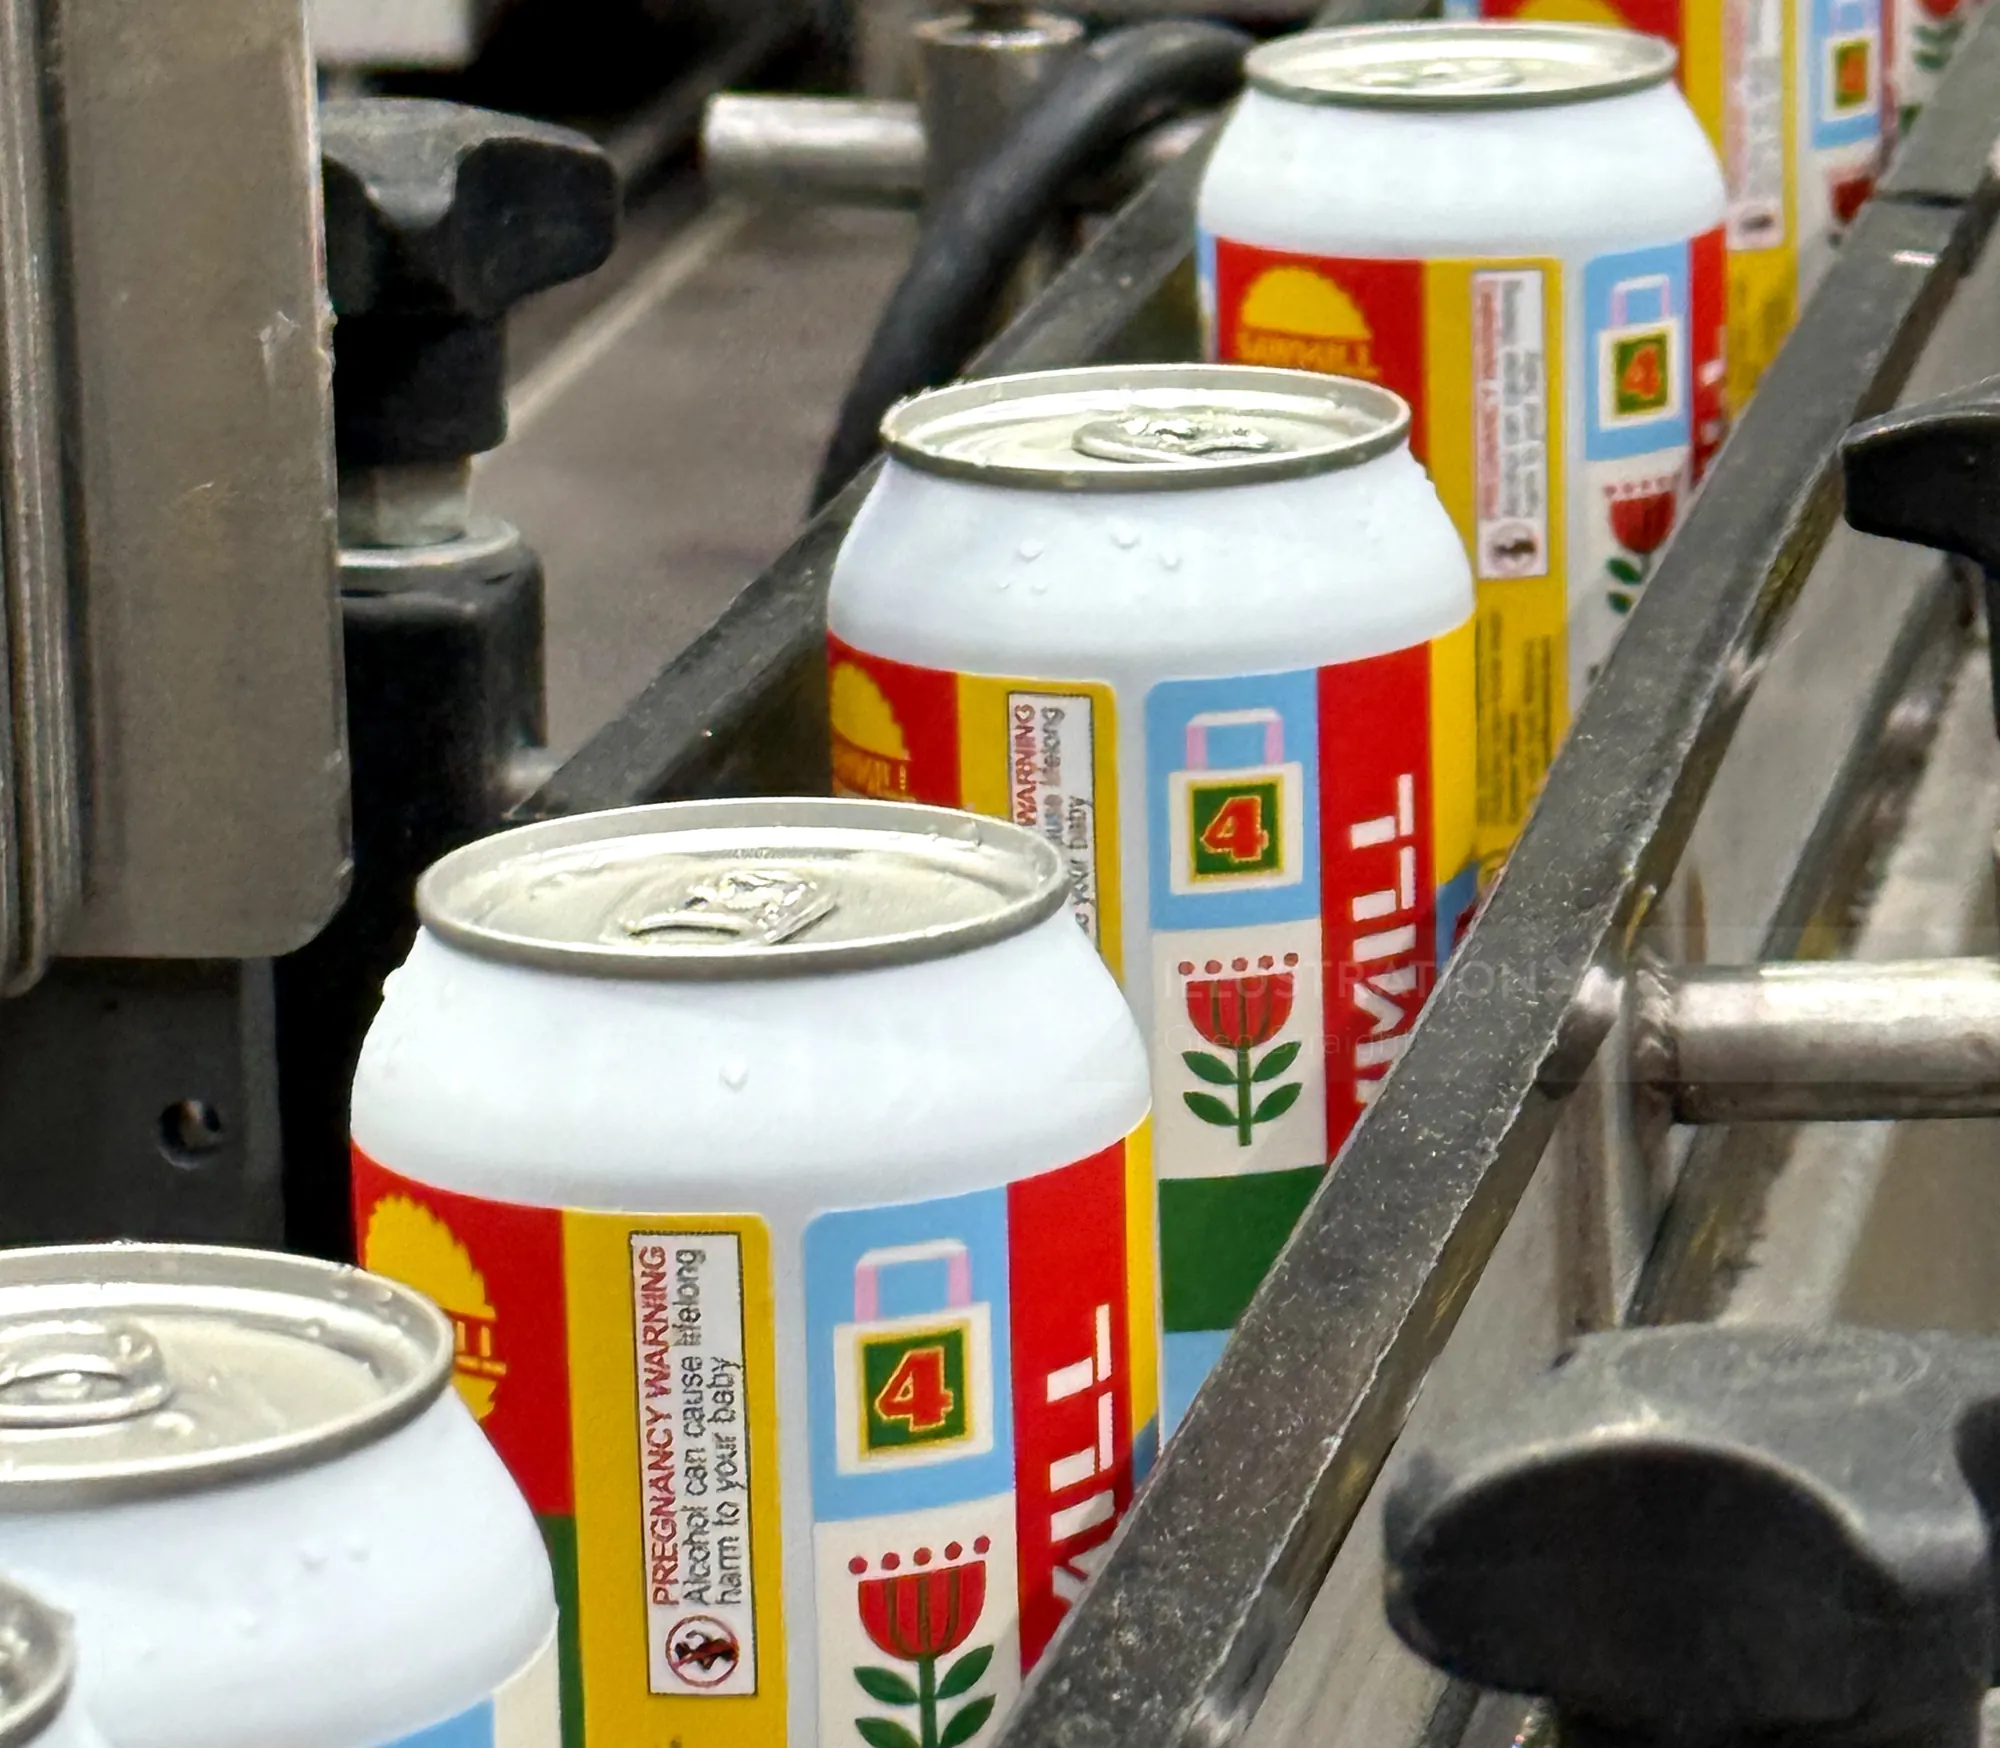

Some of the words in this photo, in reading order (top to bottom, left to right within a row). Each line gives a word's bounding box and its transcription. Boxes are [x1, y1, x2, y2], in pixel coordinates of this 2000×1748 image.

[1014, 703, 1038, 827] WARNING
[1201, 796, 1268, 862] 4
[638, 1246, 672, 1398] WARNING
[672, 1249, 706, 1346] lifelong
[681, 1356, 706, 1438] cause
[706, 1357, 741, 1423] baby
[874, 1347, 955, 1434] 4
[684, 1447, 708, 1496] can
[713, 1432, 746, 1493] your
[645, 1406, 680, 1606] PREGNANCY
[712, 1500, 740, 1527] to
[681, 1505, 711, 1605] Alcohol
[714, 1535, 742, 1604] harm
